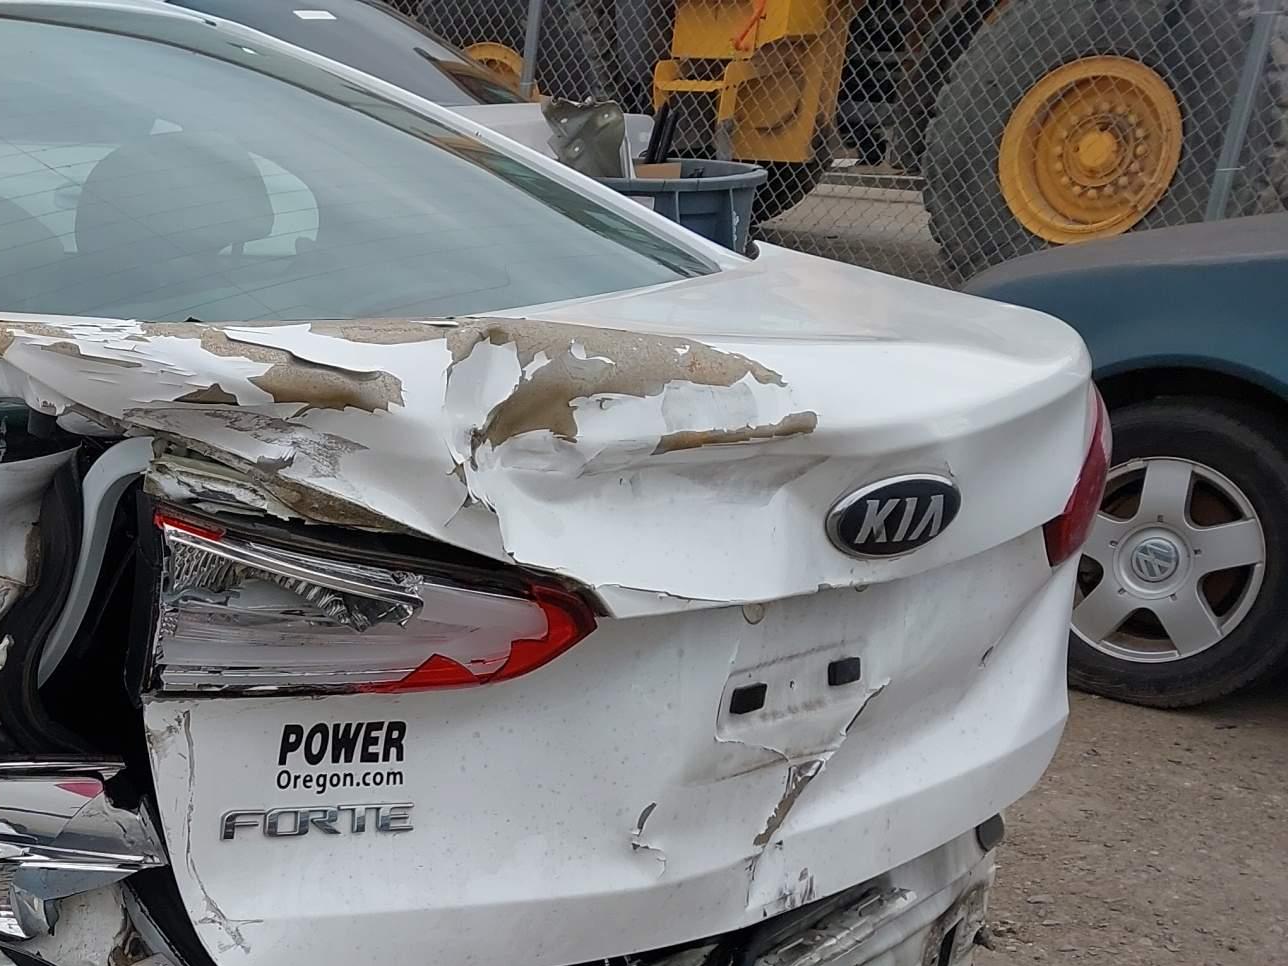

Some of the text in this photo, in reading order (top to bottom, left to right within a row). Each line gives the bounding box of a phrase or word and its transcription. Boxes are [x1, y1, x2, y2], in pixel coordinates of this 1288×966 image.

[853, 494, 945, 545] KIA
[278, 720, 408, 766] POWER
[276, 769, 404, 794] Oregon.com
[220, 802, 415, 841] FORTE
